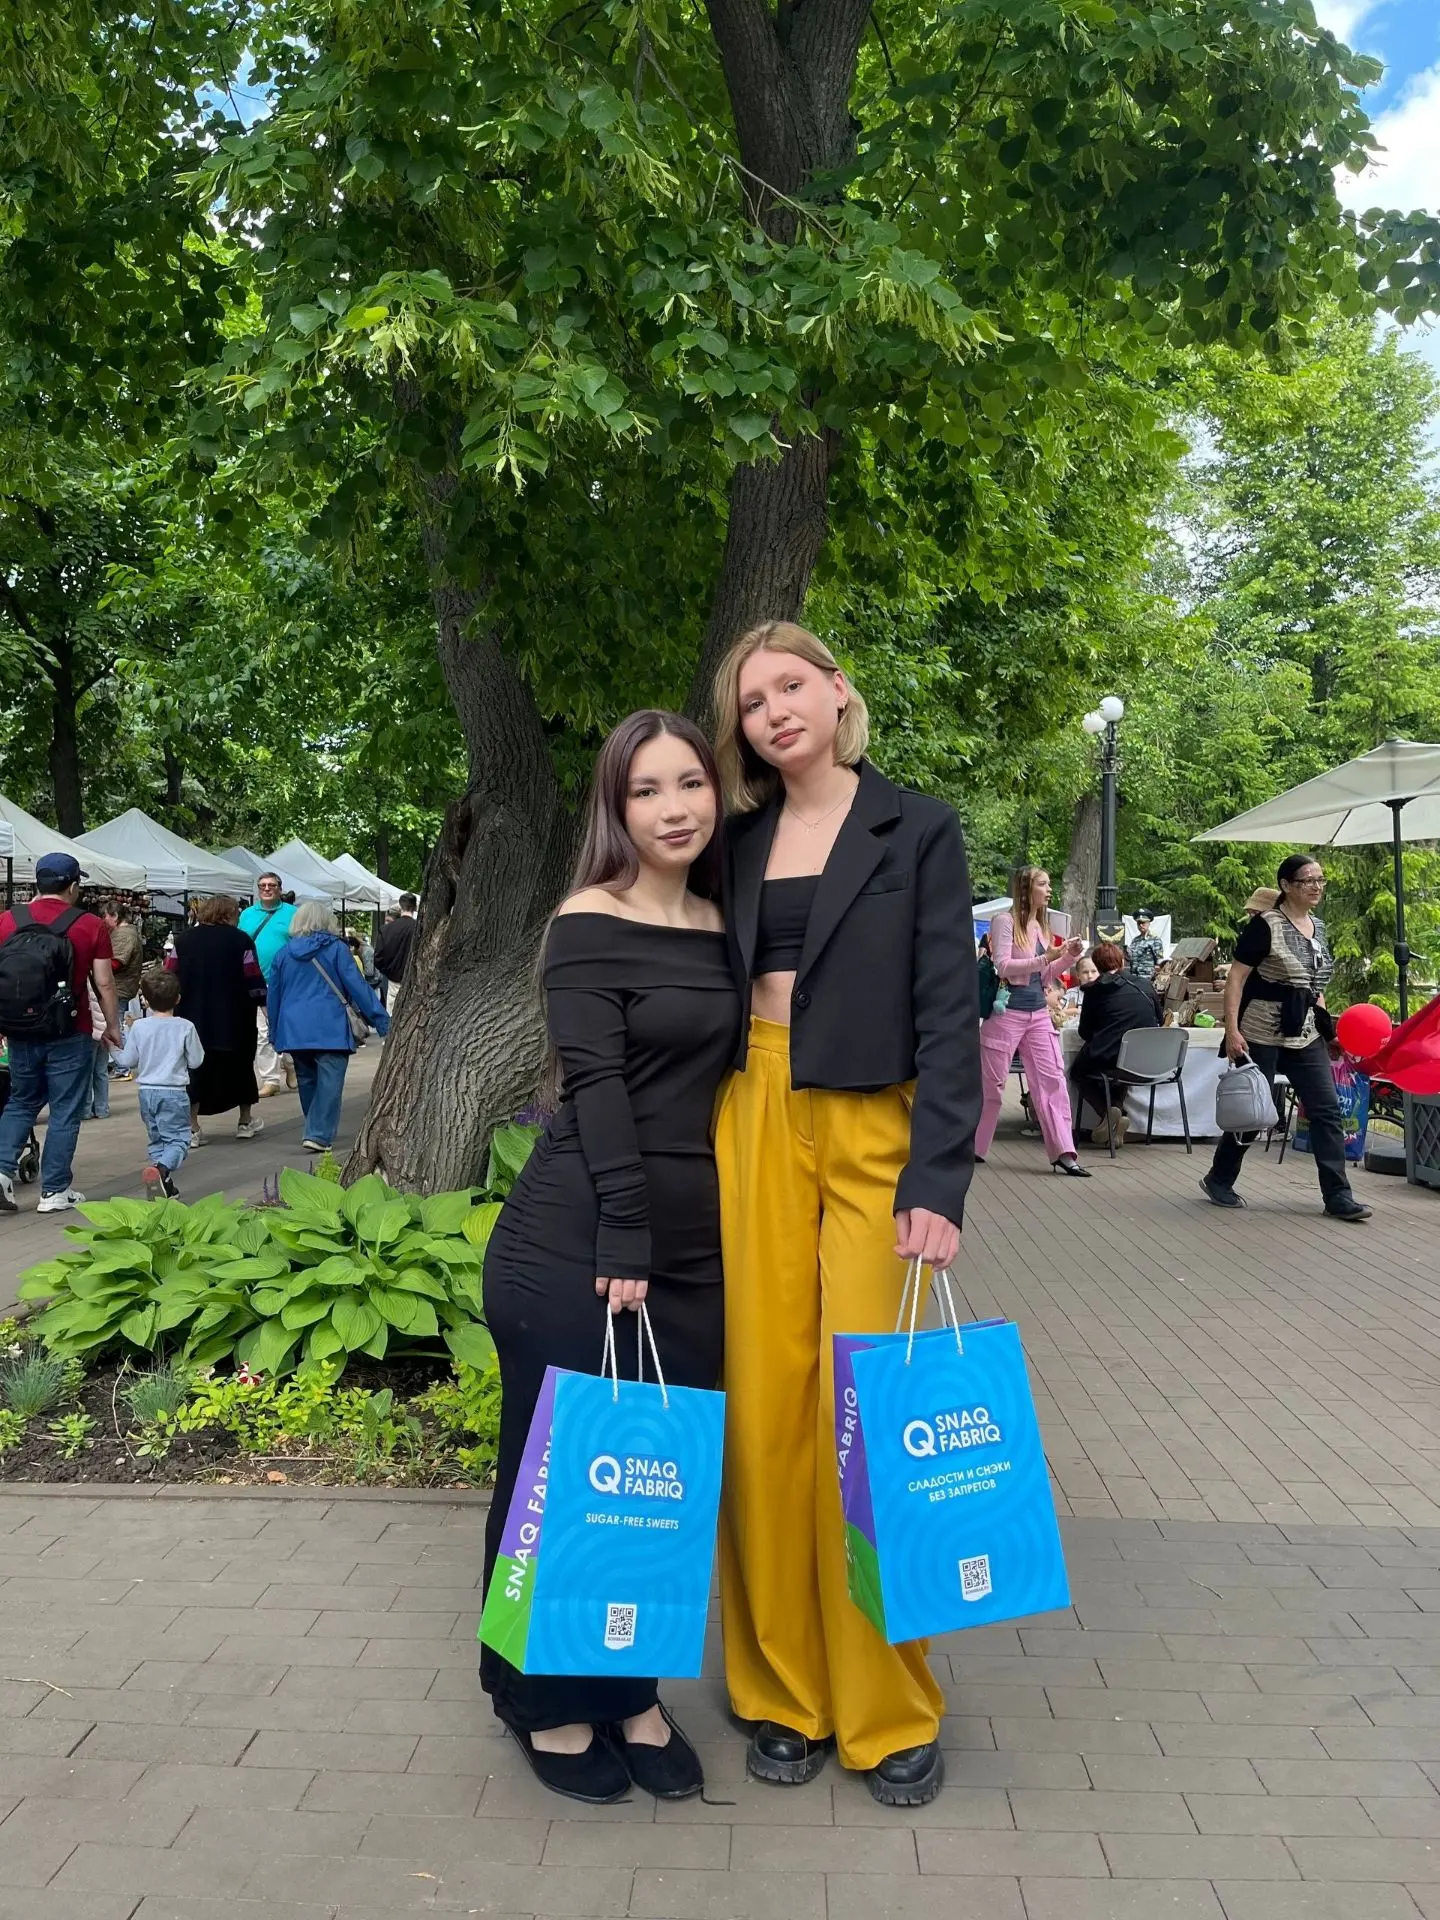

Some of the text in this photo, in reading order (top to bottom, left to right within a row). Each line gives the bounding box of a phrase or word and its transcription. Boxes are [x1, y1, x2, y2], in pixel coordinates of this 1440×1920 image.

[935, 1406, 990, 1433] SNAQ
[903, 1420, 938, 1457] Q
[939, 1424, 1002, 1452] FABRIQ
[589, 1455, 621, 1495] Q
[625, 1457, 677, 1480] SNAQ
[908, 1461, 1012, 1492] СЛАДОСТИ И СНЭКИ
[624, 1477, 683, 1500] FABRIQ
[929, 1478, 996, 1502] БЕЗ ЗАПРЕТОВ
[505, 1425, 554, 1602] SNAQ FAB
[585, 1512, 679, 1530] SUGAR-FREE SWEETS
